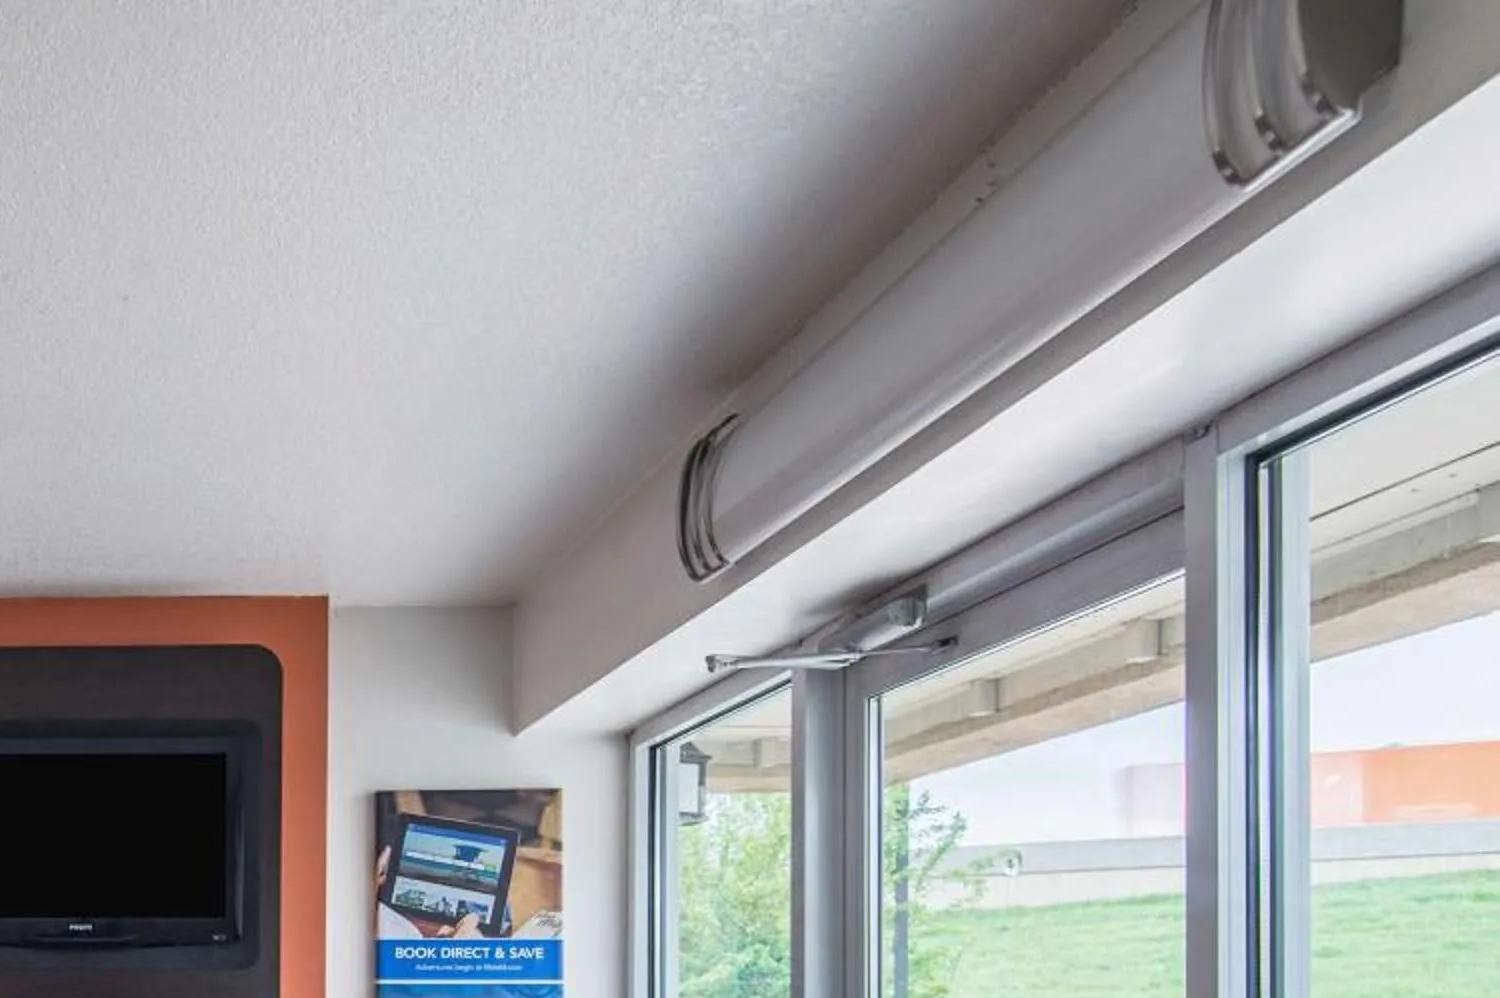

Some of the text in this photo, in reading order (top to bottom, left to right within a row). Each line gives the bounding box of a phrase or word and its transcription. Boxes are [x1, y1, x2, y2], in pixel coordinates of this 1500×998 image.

[395, 946, 545, 959] BOOK DIRECT & SAVE
